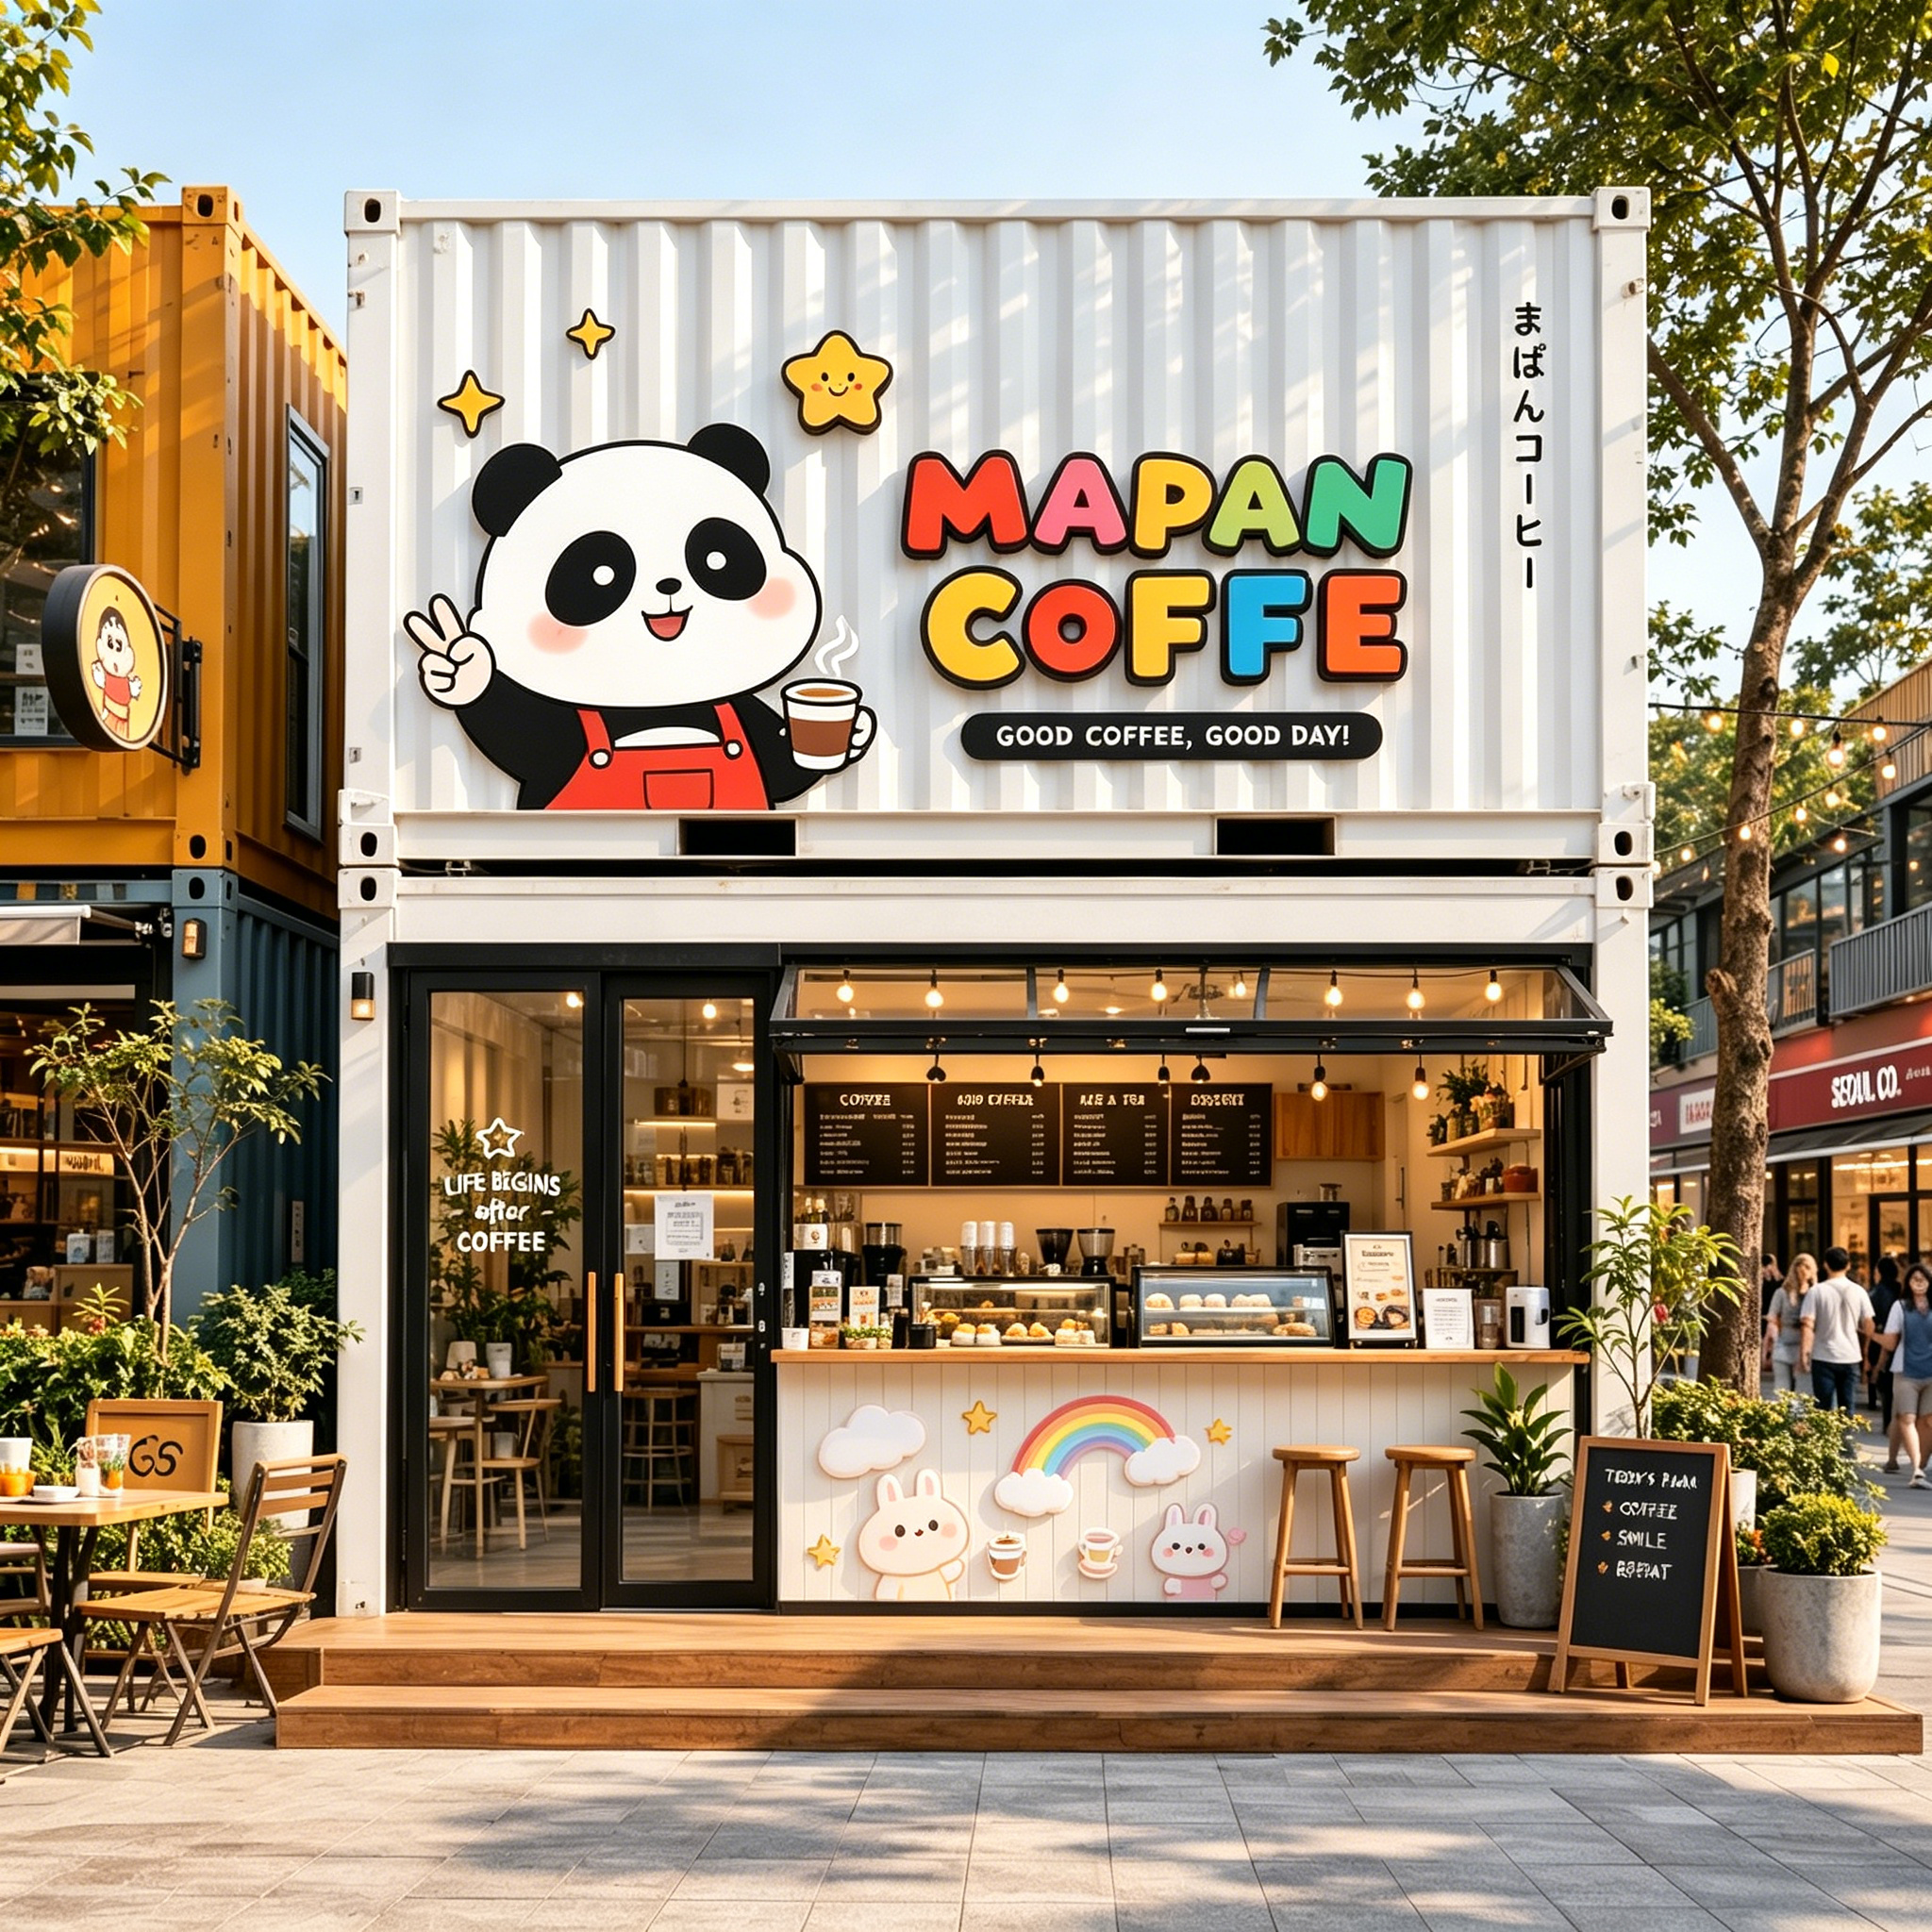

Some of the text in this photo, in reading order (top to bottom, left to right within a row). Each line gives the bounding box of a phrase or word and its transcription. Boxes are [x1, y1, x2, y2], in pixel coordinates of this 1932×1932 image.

[1513, 302, 1546, 589] まぱんコーヒー
[903, 450, 1413, 558] MAPAN
[921, 566, 1407, 689] COFFE
[996, 724, 1350, 751] GOOD COFFEE, GOOD DAY!
[491, 1170, 561, 1196] BEGINS
[457, 1230, 546, 1253] COFFEE
